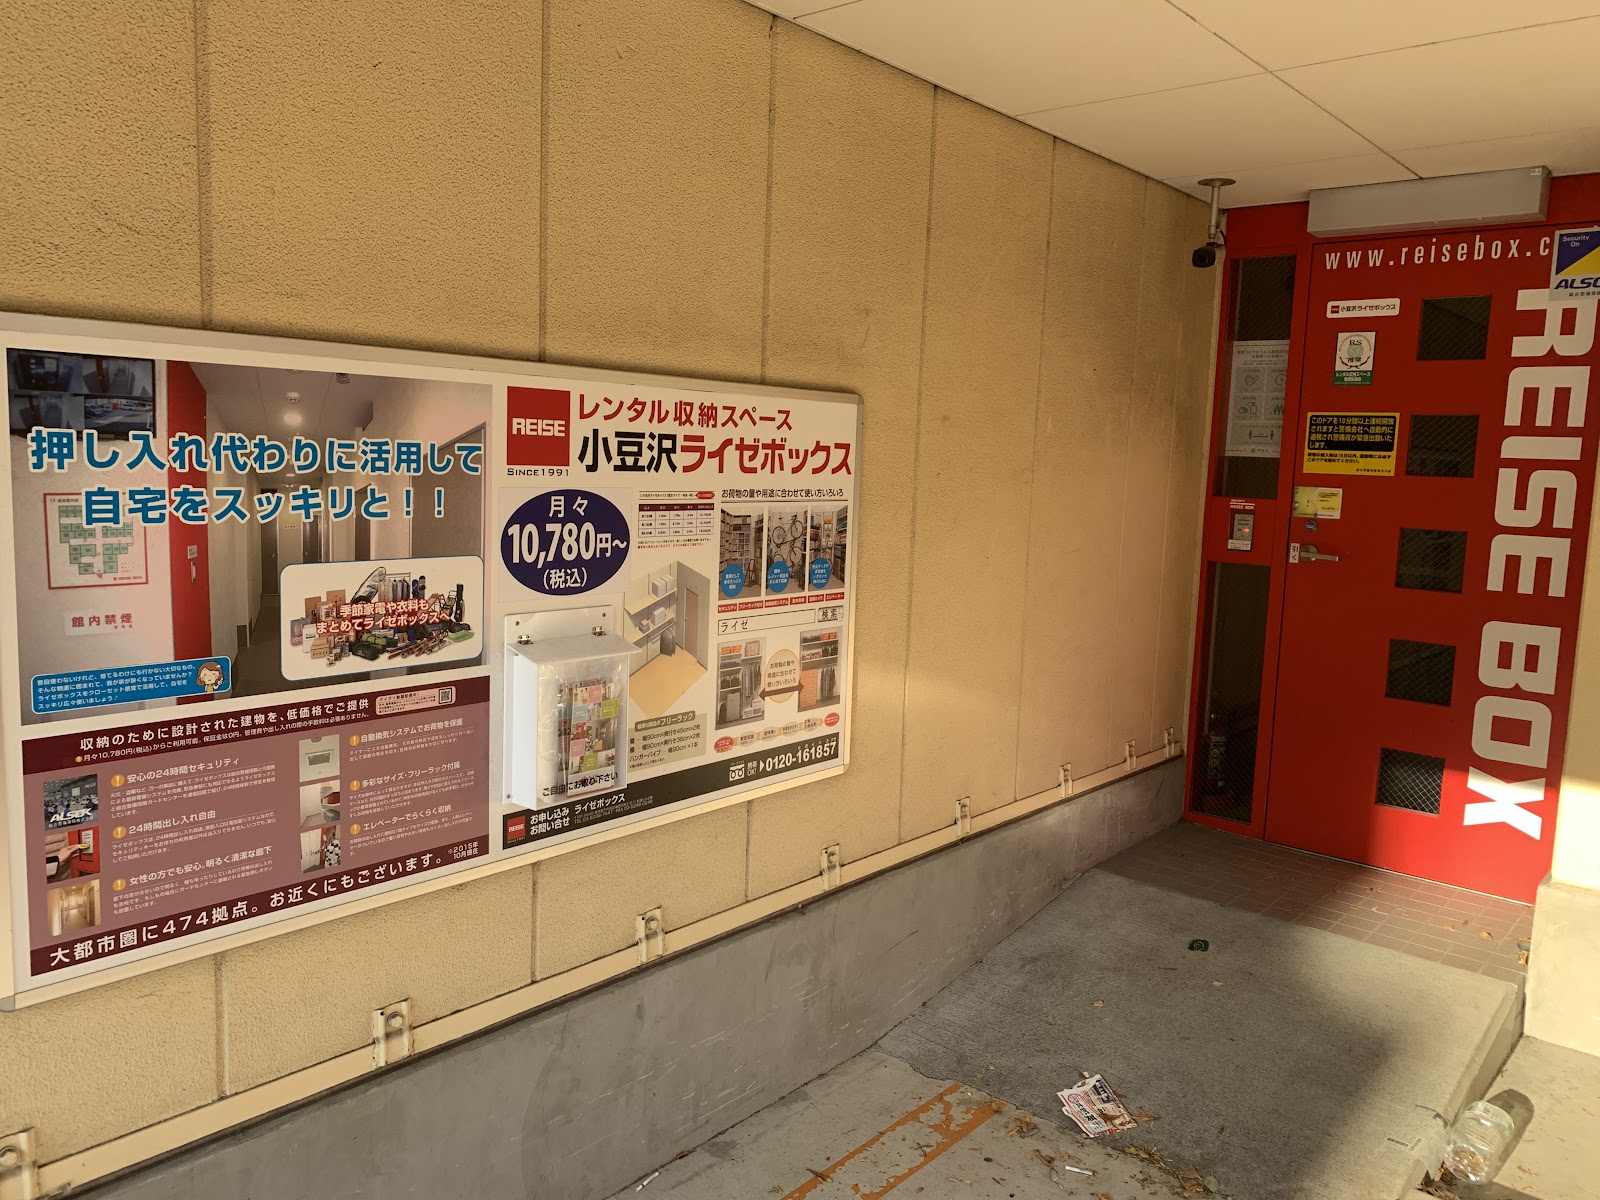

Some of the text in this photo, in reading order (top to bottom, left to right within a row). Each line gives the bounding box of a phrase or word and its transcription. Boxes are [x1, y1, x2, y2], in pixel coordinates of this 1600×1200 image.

[1562, 235, 1590, 243] Security
[1325, 234, 1550, 270] www.reisebox.c
[1341, 304, 1396, 312] 小豆沢ライゼボックス
[577, 392, 793, 432] レンタル収納スペース
[512, 417, 566, 437] REISE
[29, 428, 484, 474] 押し入れ代わりに活用して
[577, 427, 852, 476] 小豆沢ライゼボックス
[1486, 288, 1597, 598] REISE
[721, 488, 844, 499] お荷物の量や用途に合わせて使い方いろいろ
[83, 486, 446, 527] 自宅をスッキリと！！
[548, 495, 590, 518] 月々
[1292, 545, 1299, 561] 引く
[340, 598, 429, 618] 季節家電や衣料も
[821, 608, 838, 620] 検索
[71, 613, 133, 628] 館内禁煙
[316, 612, 451, 635] まとめてライゼボックスへ
[721, 619, 749, 633] ライゼ
[767, 668, 797, 679] 用途に合わせて
[769, 660, 795, 669] お荷物の量や
[767, 677, 797, 688] 使い方いろいろ
[80, 698, 369, 751] 収納のために設計された建物を、低価格でご提供
[361, 718, 463, 743] 自動換気システムでお荷物を保護
[1463, 620, 1562, 840] BOX
[630, 750, 661, 762] ハンガーパイプ
[765, 741, 837, 772] 0120-161857
[127, 758, 240, 784] 安心の24時間セキュリティ
[362, 761, 461, 788] 多彩なサイズ・フリーラック付属
[542, 772, 619, 796] ご自由にお取り下さい
[574, 793, 626, 815] ライゼボックス
[49, 808, 93, 823] ALSOK
[128, 810, 216, 834] 24時間出し入れ自由
[363, 804, 452, 831] エレベーターでらくらく収納
[530, 807, 570, 825] お申し込み
[530, 817, 571, 836] お問い合せ
[508, 823, 525, 833] REISE
[453, 847, 479, 860] 10月現在
[129, 846, 273, 886] 女性の方でも安心。明るく清潔な廊下
[50, 852, 443, 968] 大都市圏に474拠点。 お近くにもございます。
